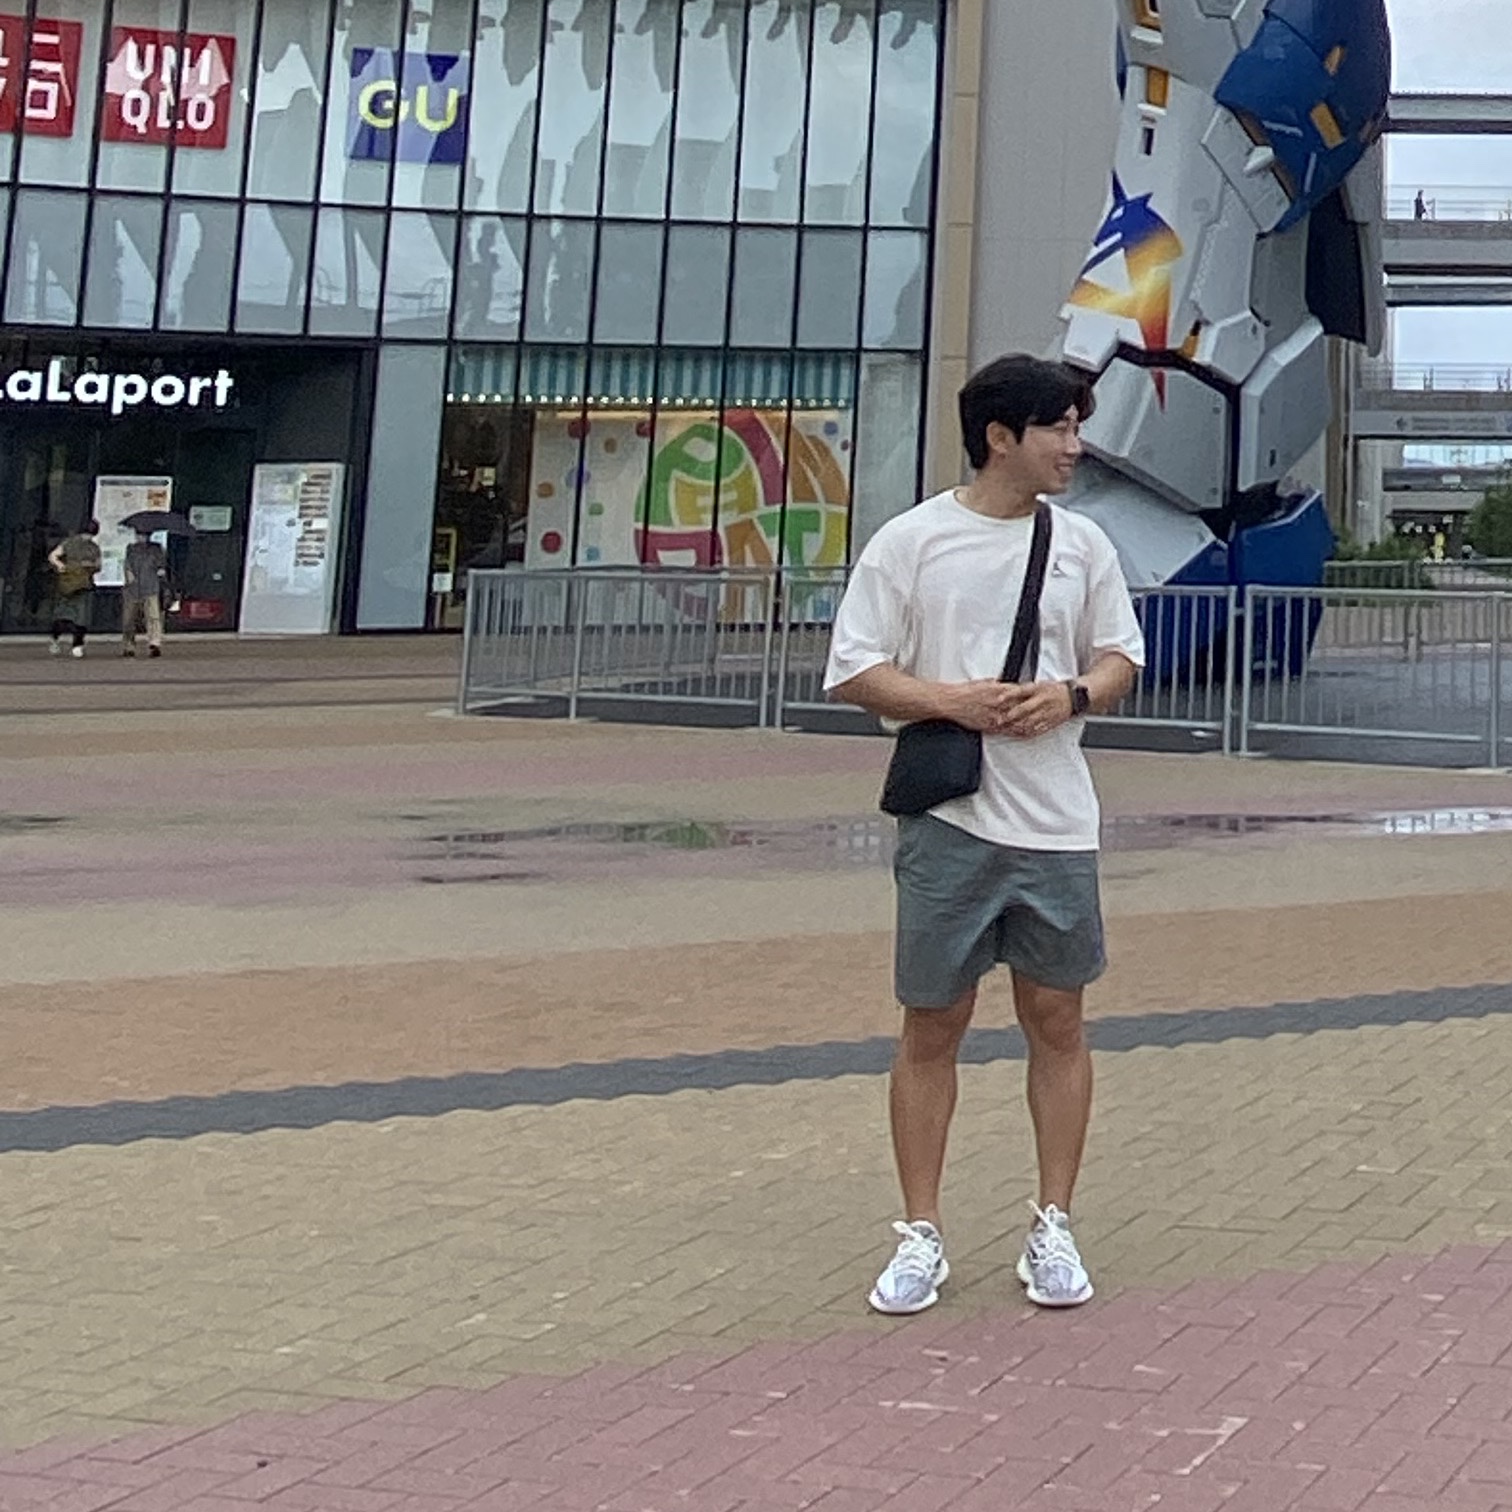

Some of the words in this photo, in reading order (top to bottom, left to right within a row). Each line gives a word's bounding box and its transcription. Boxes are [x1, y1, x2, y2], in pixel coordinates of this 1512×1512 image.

[126, 42, 212, 86] UNI
[122, 89, 216, 134] QLO
[359, 80, 459, 132] GU
[0, 360, 234, 416] aLaport
